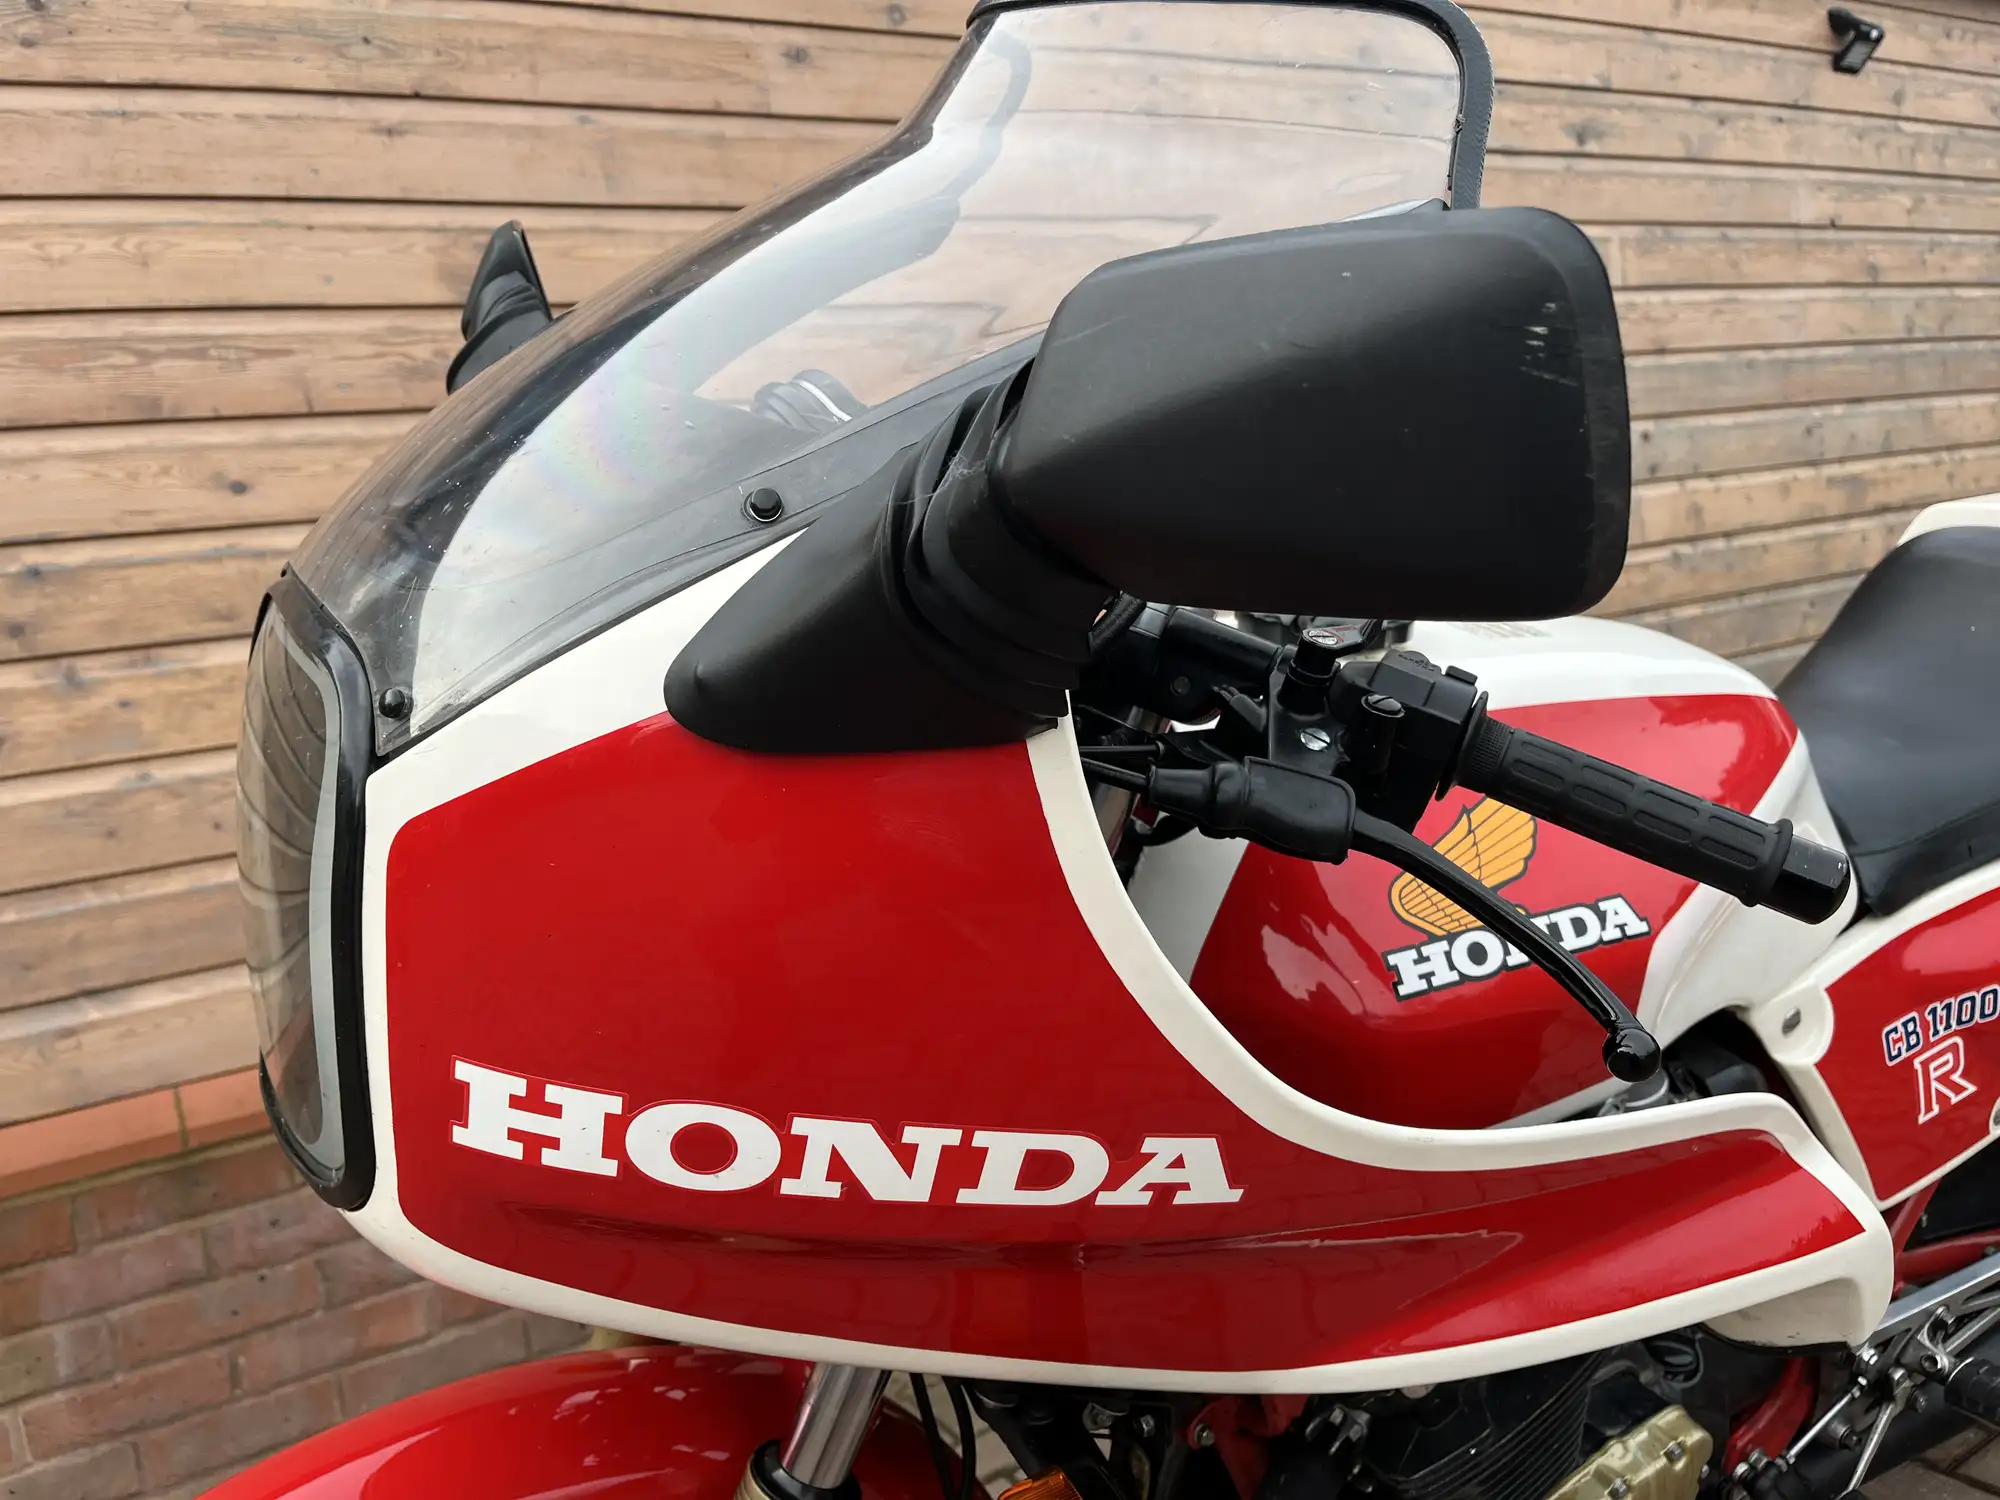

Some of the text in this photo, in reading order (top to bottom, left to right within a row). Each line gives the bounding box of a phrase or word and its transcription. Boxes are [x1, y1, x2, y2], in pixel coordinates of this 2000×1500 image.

[1883, 985, 1999, 1065] CB 1100
[1913, 1036, 1977, 1124] R
[453, 1059, 1244, 1206] HONDA
